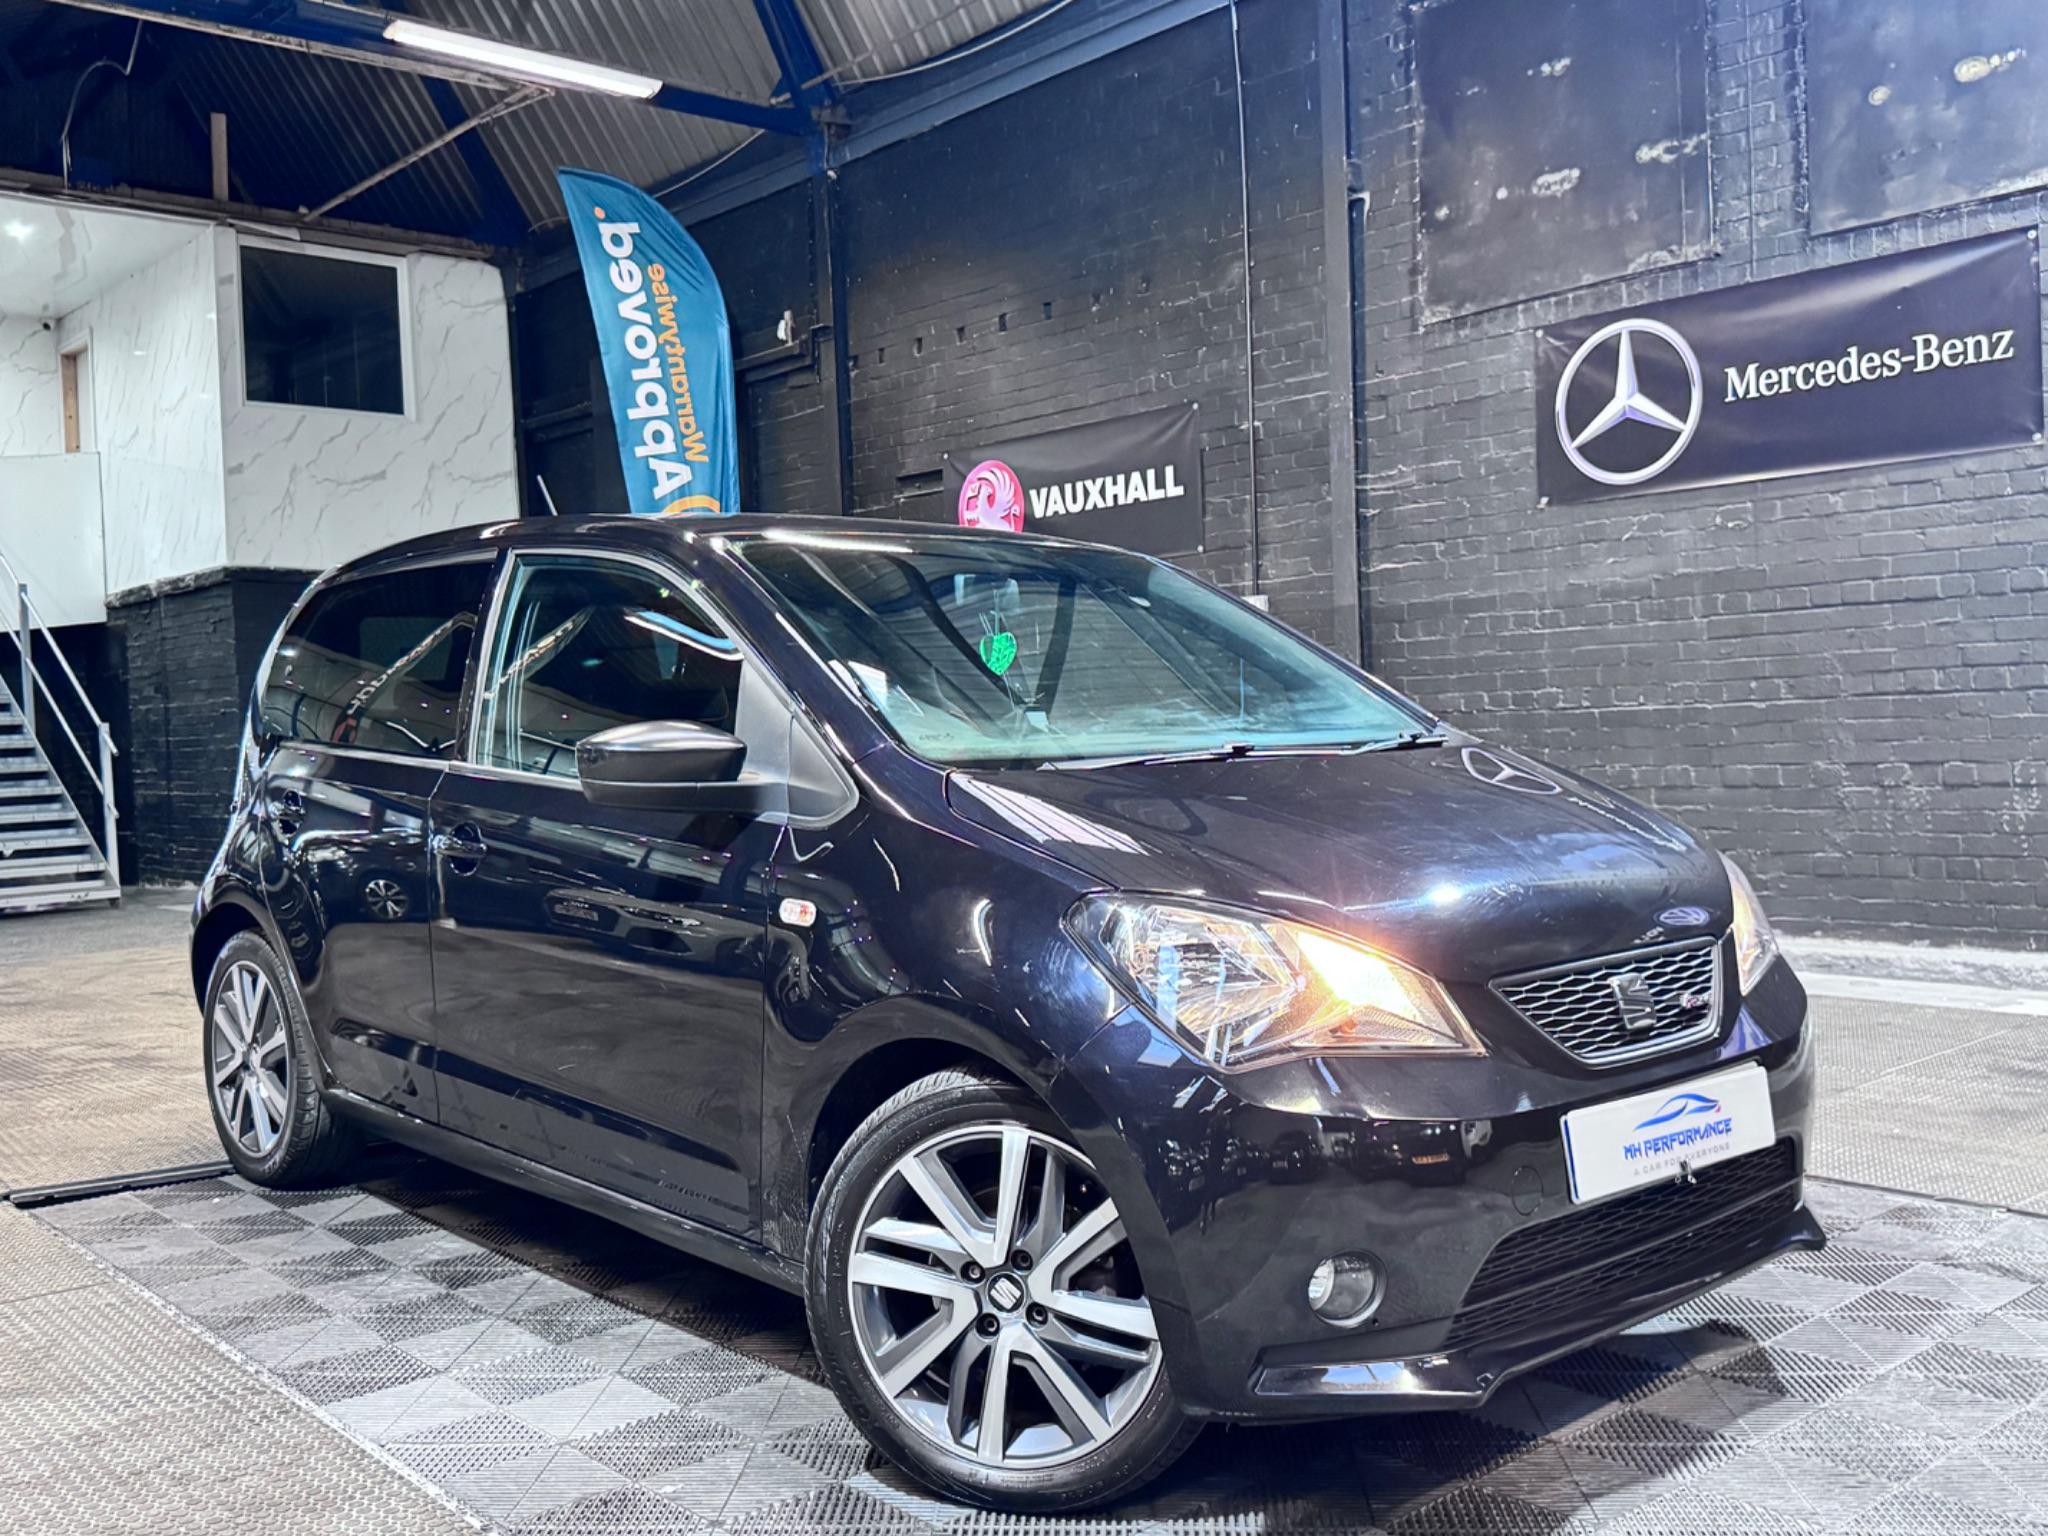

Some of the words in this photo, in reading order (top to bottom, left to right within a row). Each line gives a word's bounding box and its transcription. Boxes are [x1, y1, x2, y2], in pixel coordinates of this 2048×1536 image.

[1724, 329, 2014, 402] Mercedes-Benz
[1029, 465, 1185, 519] VAUXHALL
[1643, 1118, 1732, 1157] PERFORMANCE
[1643, 1161, 1662, 1174] CAR
